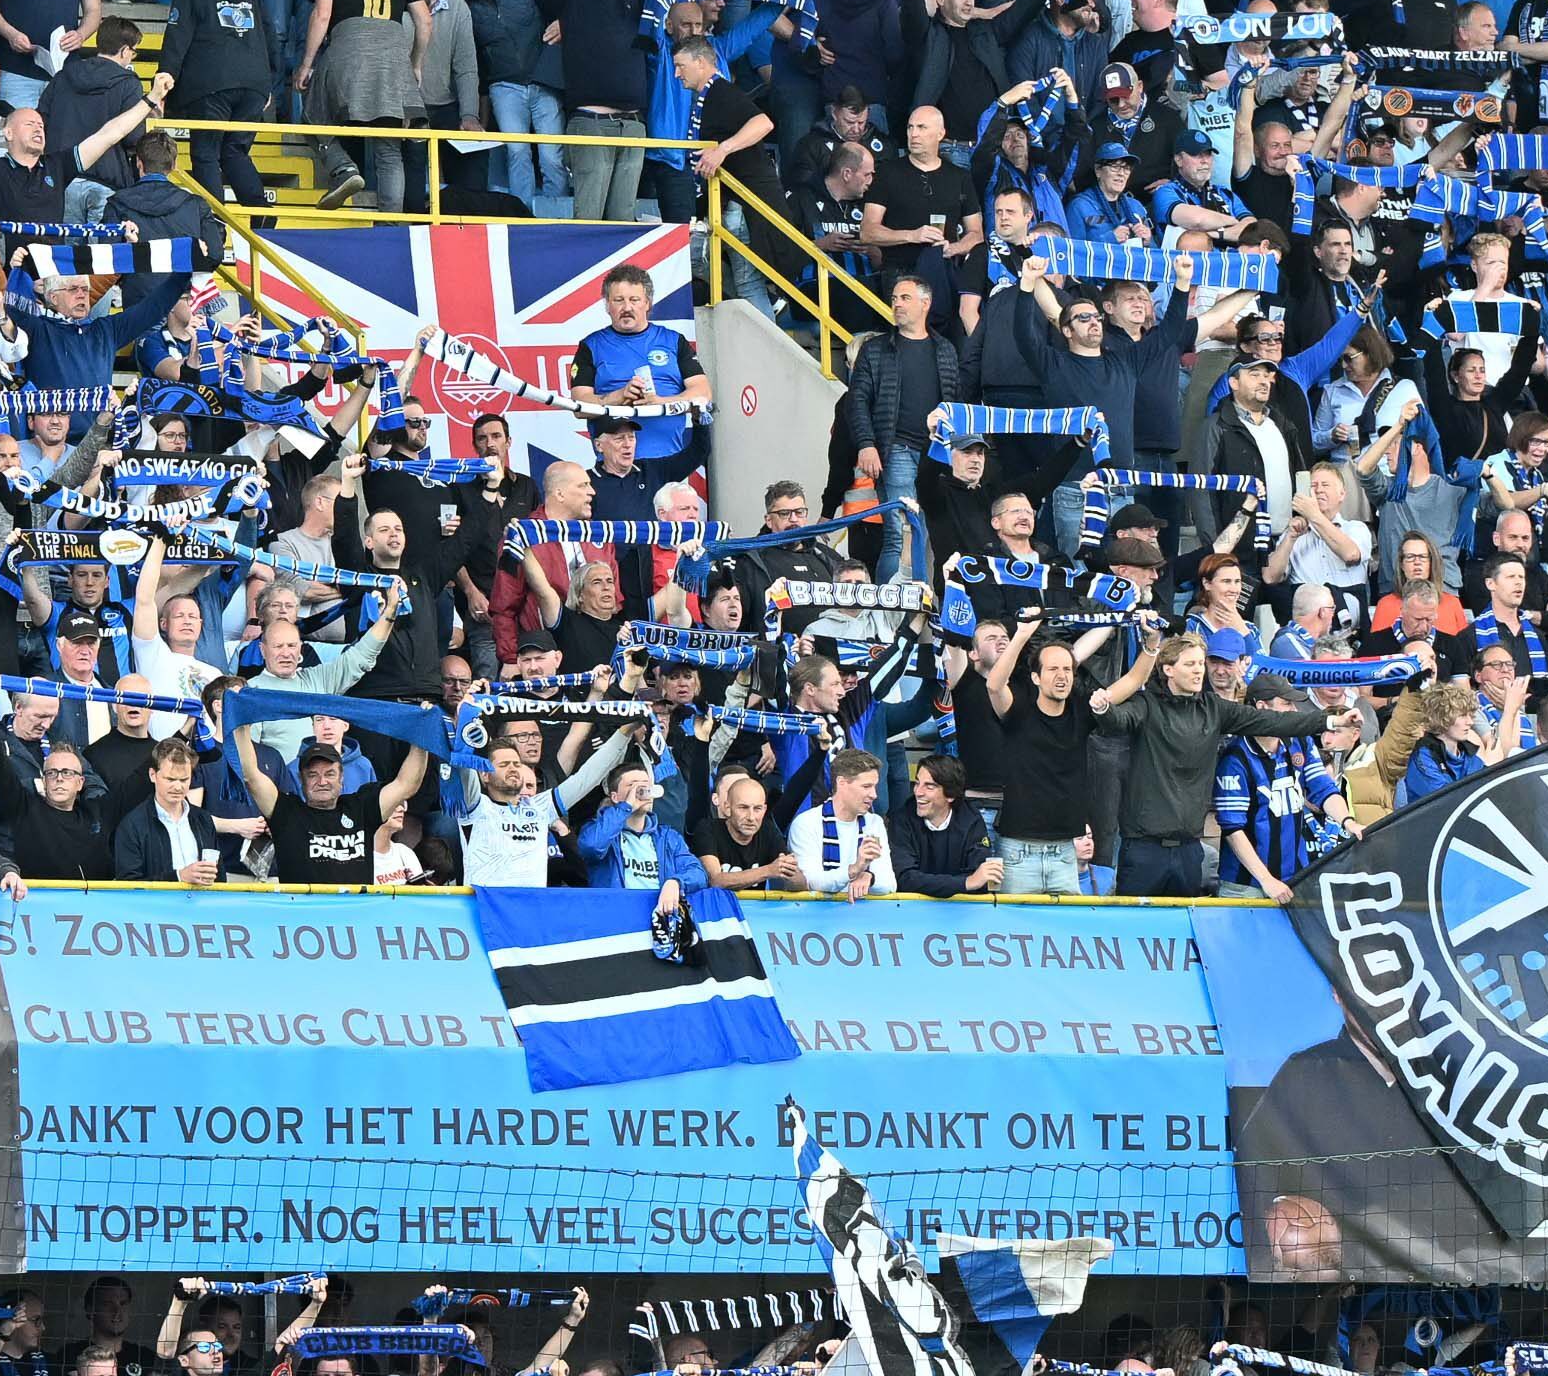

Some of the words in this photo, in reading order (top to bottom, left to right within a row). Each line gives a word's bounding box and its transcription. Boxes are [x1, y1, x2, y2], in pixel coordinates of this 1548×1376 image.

[1455, 48, 1508, 64] ZELZATE
[788, 579, 920, 612] BRUGGE
[272, 924, 359, 961] JOU
[377, 925, 471, 963] HAD
[768, 930, 905, 968] NOOIT
[922, 933, 1126, 971] GESTAAN
[164, 1010, 328, 1047] TERUG
[887, 1020, 950, 1054] DE
[959, 1019, 1048, 1055] TOP
[1061, 1021, 1120, 1055] TE
[173, 1105, 305, 1146] VOOR
[324, 1105, 413, 1147] HET
[431, 1106, 590, 1148] HARDE
[608, 1107, 756, 1149] WERK.
[1007, 1112, 1078, 1151] OM
[1092, 1113, 1145, 1152] TE
[74, 1201, 265, 1245] TOPPER.
[398, 1204, 513, 1245] HEEL
[524, 1205, 637, 1245] VEEL
